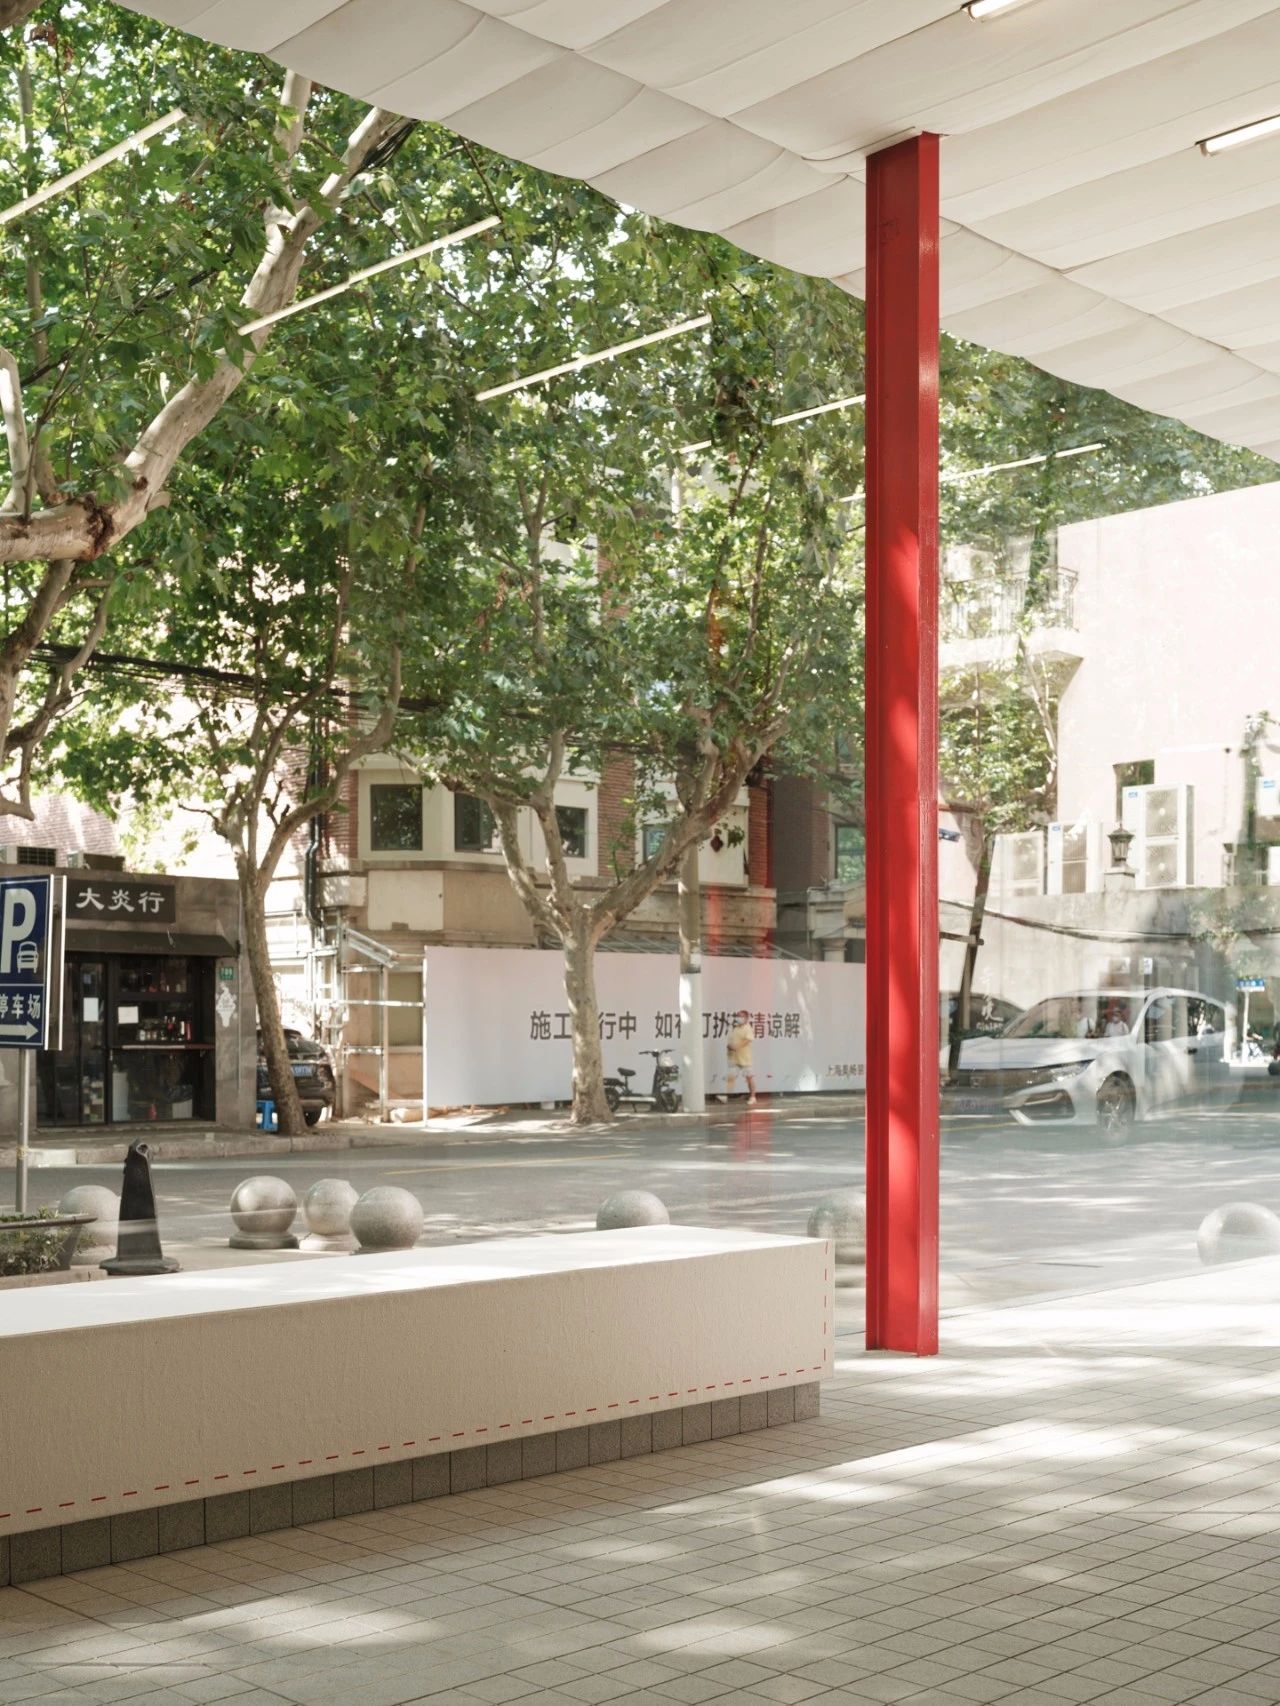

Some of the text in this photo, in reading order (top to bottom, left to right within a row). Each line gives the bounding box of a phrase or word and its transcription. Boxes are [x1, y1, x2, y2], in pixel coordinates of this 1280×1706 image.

[76, 887, 165, 913] 大炎行
[0, 888, 36, 974] P
[0, 993, 41, 1019] 停车场
[530, 1010, 800, 1040] 施工行中 如扰请谅解
